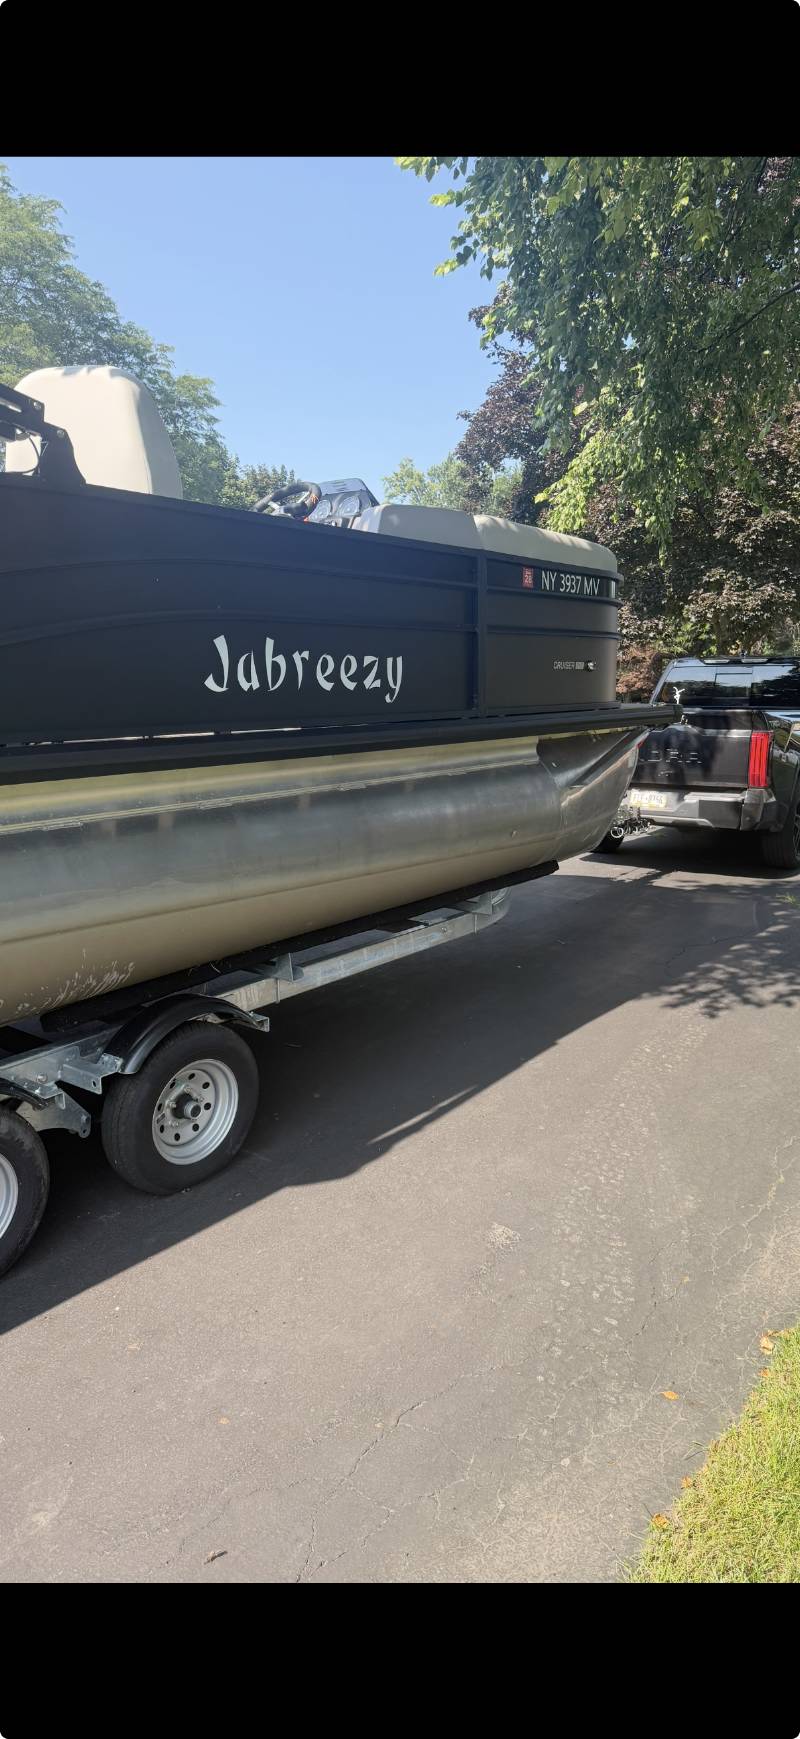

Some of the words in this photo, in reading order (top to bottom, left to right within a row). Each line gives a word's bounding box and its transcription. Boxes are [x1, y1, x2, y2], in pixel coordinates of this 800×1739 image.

[541, 570, 557, 591] NY
[559, 574, 582, 594] 3937
[583, 577, 600, 596] MV
[204, 635, 403, 704] Jabreezy
